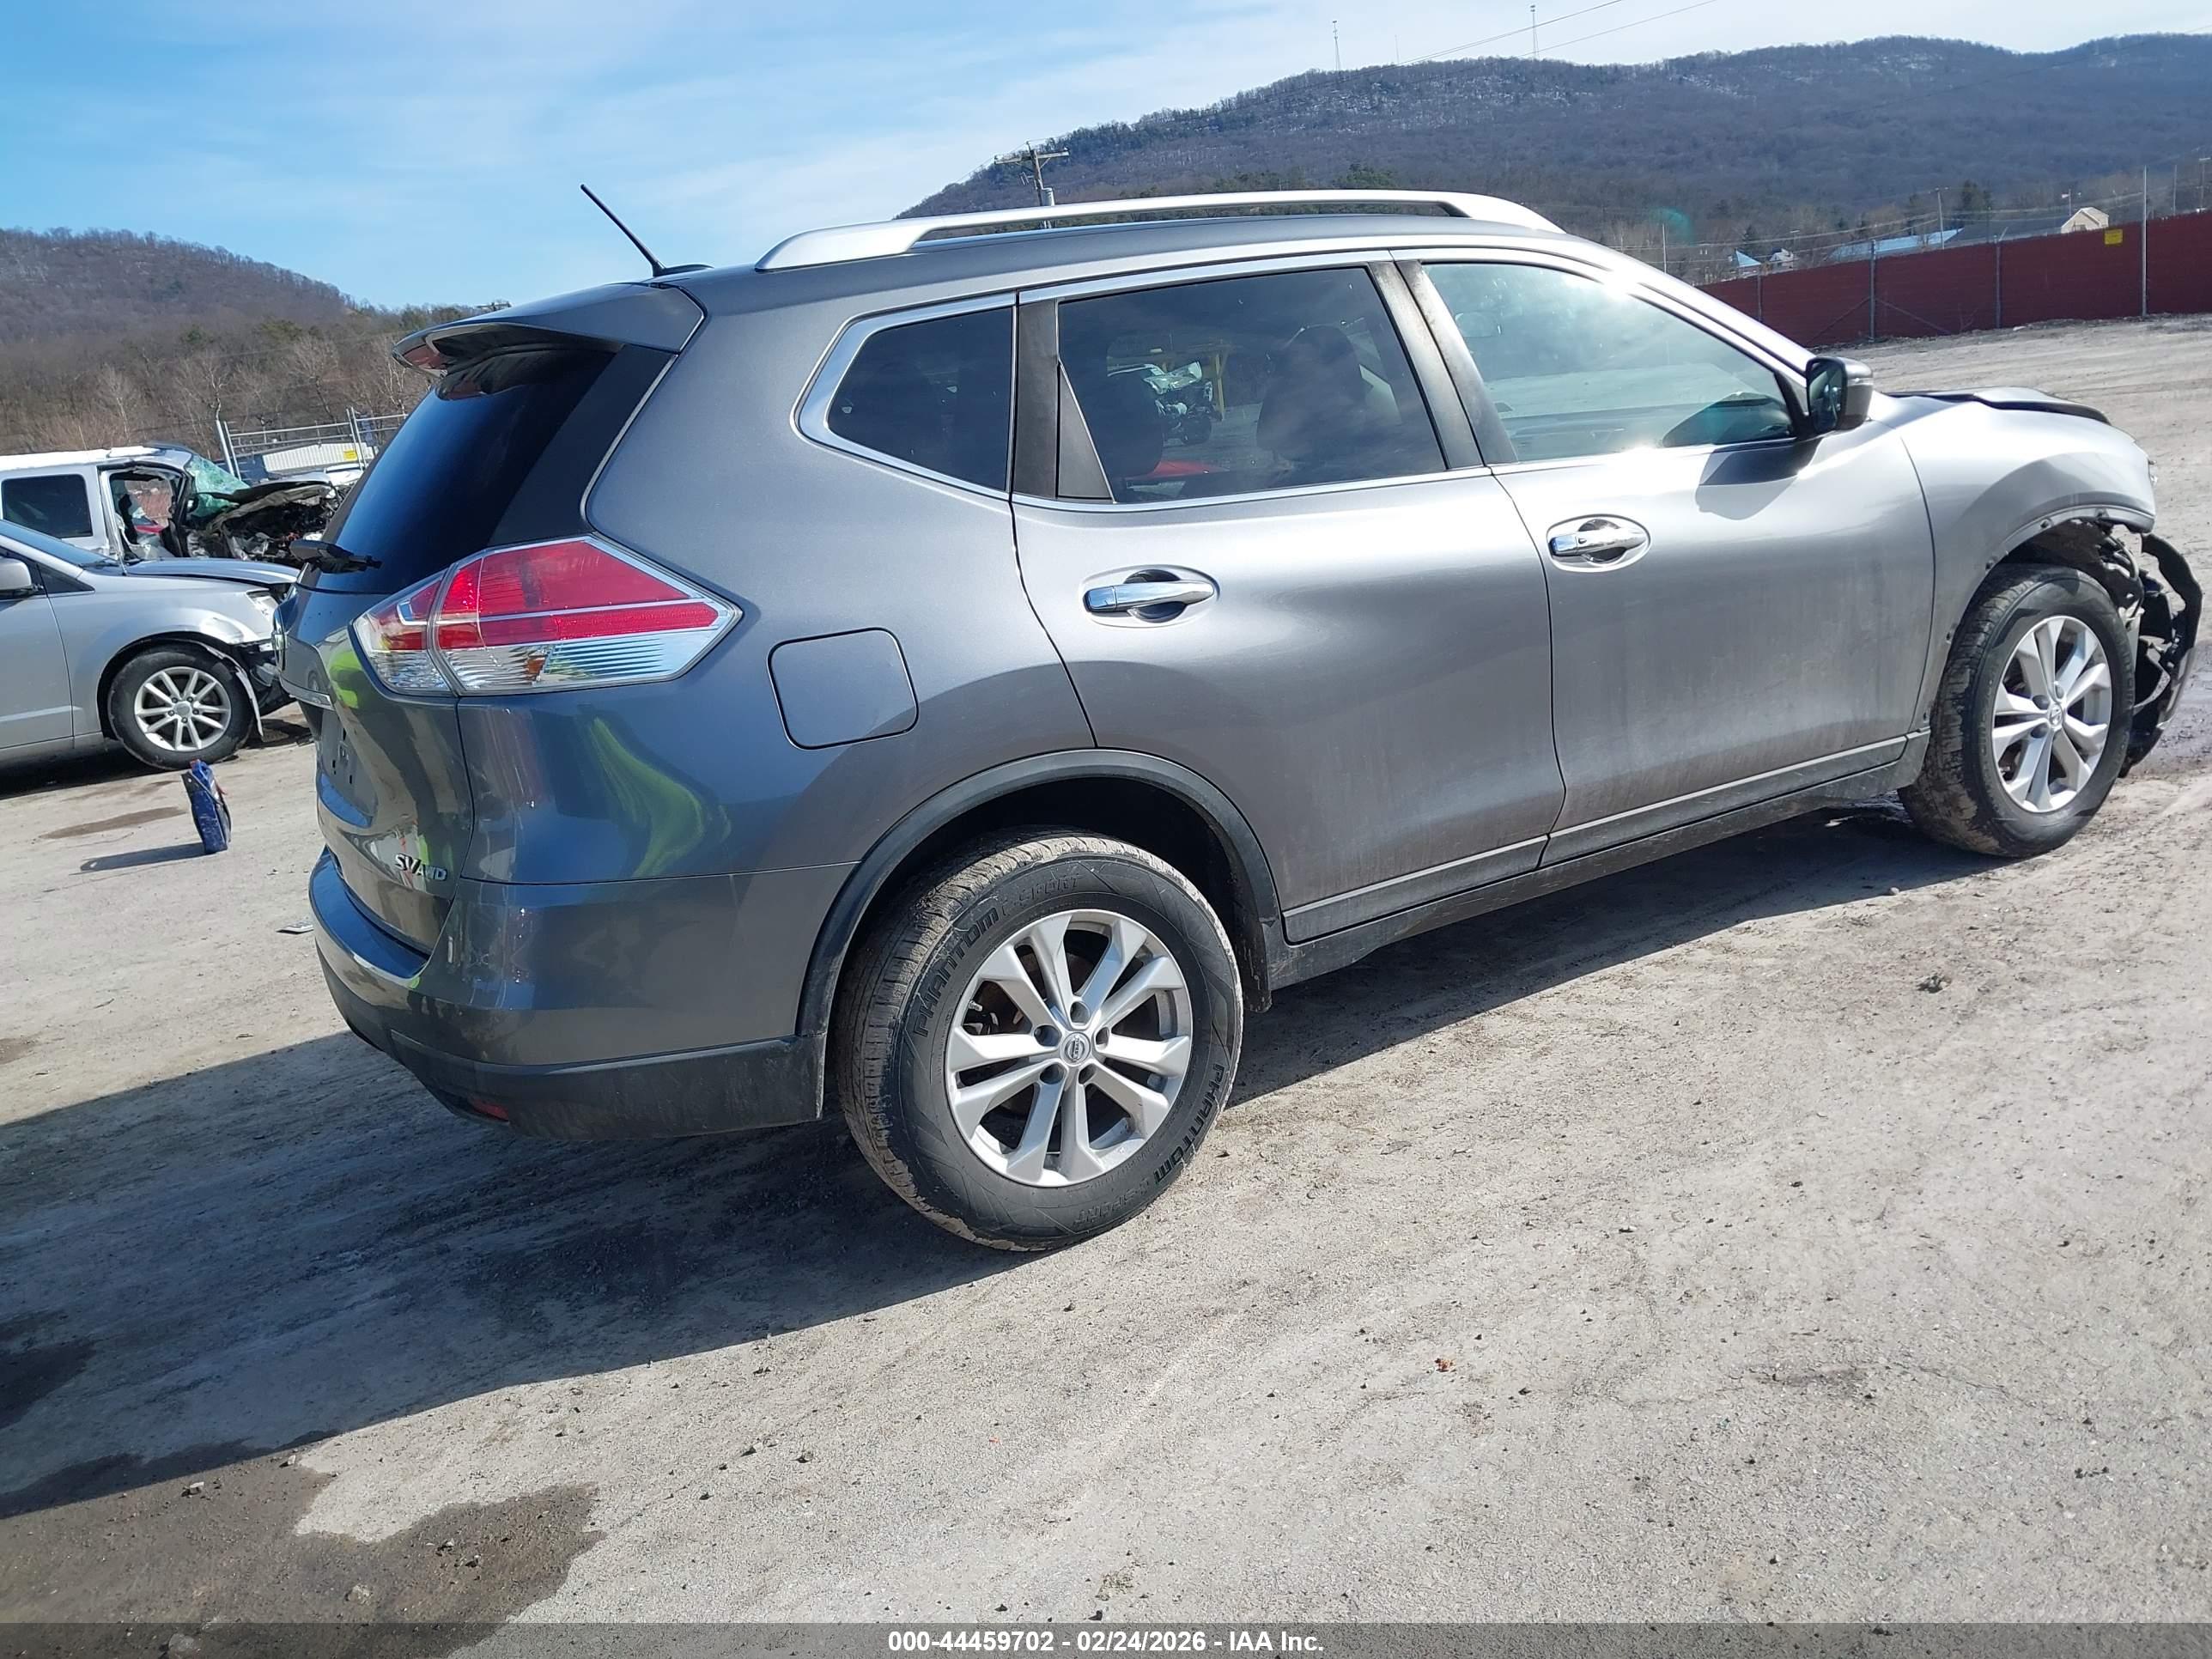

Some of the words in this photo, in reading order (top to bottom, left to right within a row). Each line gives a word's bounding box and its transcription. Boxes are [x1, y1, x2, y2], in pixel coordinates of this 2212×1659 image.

[395, 854, 422, 874] SV
[913, 907, 1000, 1038] PHANTOM
[1152, 1063, 1225, 1184] PHANTOM
